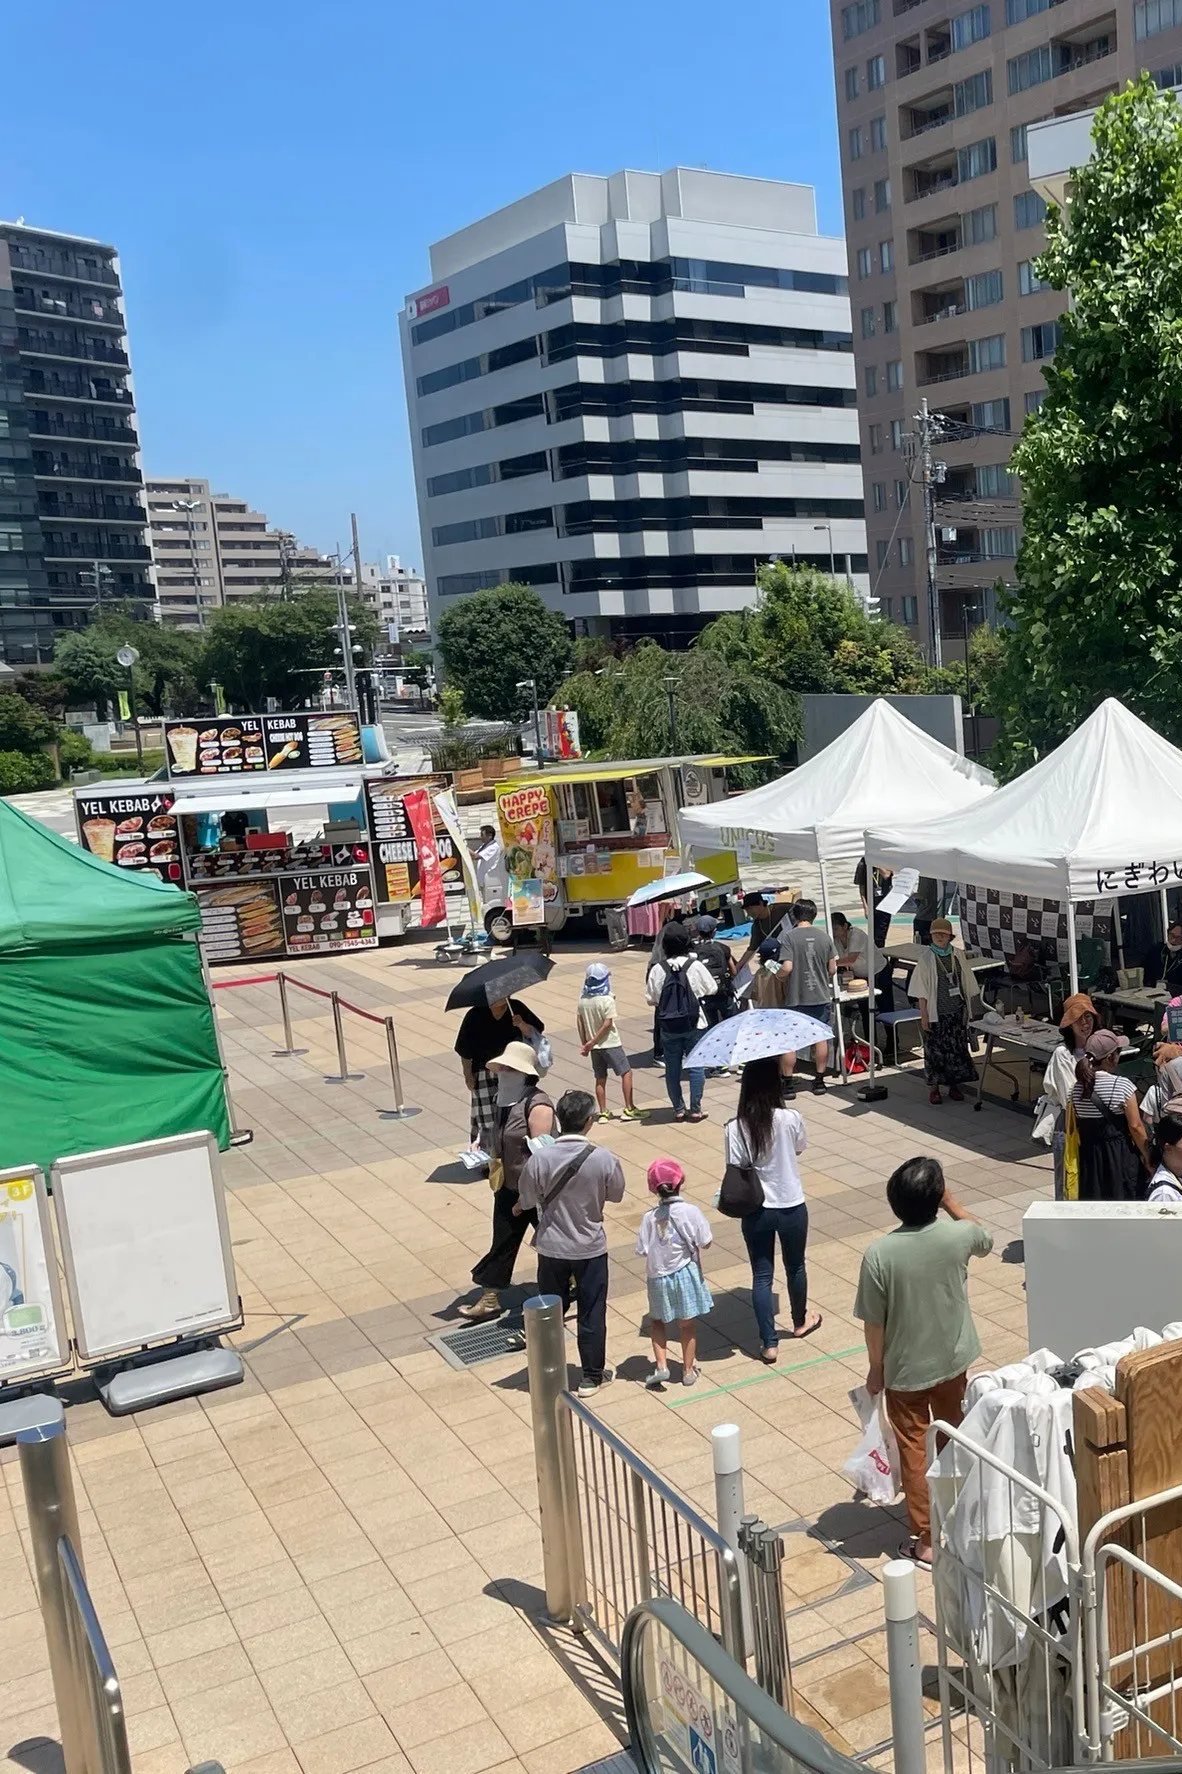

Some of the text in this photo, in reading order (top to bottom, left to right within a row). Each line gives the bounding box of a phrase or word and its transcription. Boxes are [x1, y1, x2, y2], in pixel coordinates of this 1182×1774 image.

[241, 718, 296, 732] YEL KEBAB
[81, 798, 151, 816] YEL KEBAB
[502, 790, 543, 808] HAPPY
[507, 800, 548, 820] CREPE
[379, 841, 414, 864] CHEESE
[293, 873, 359, 891] YEL KEBAB
